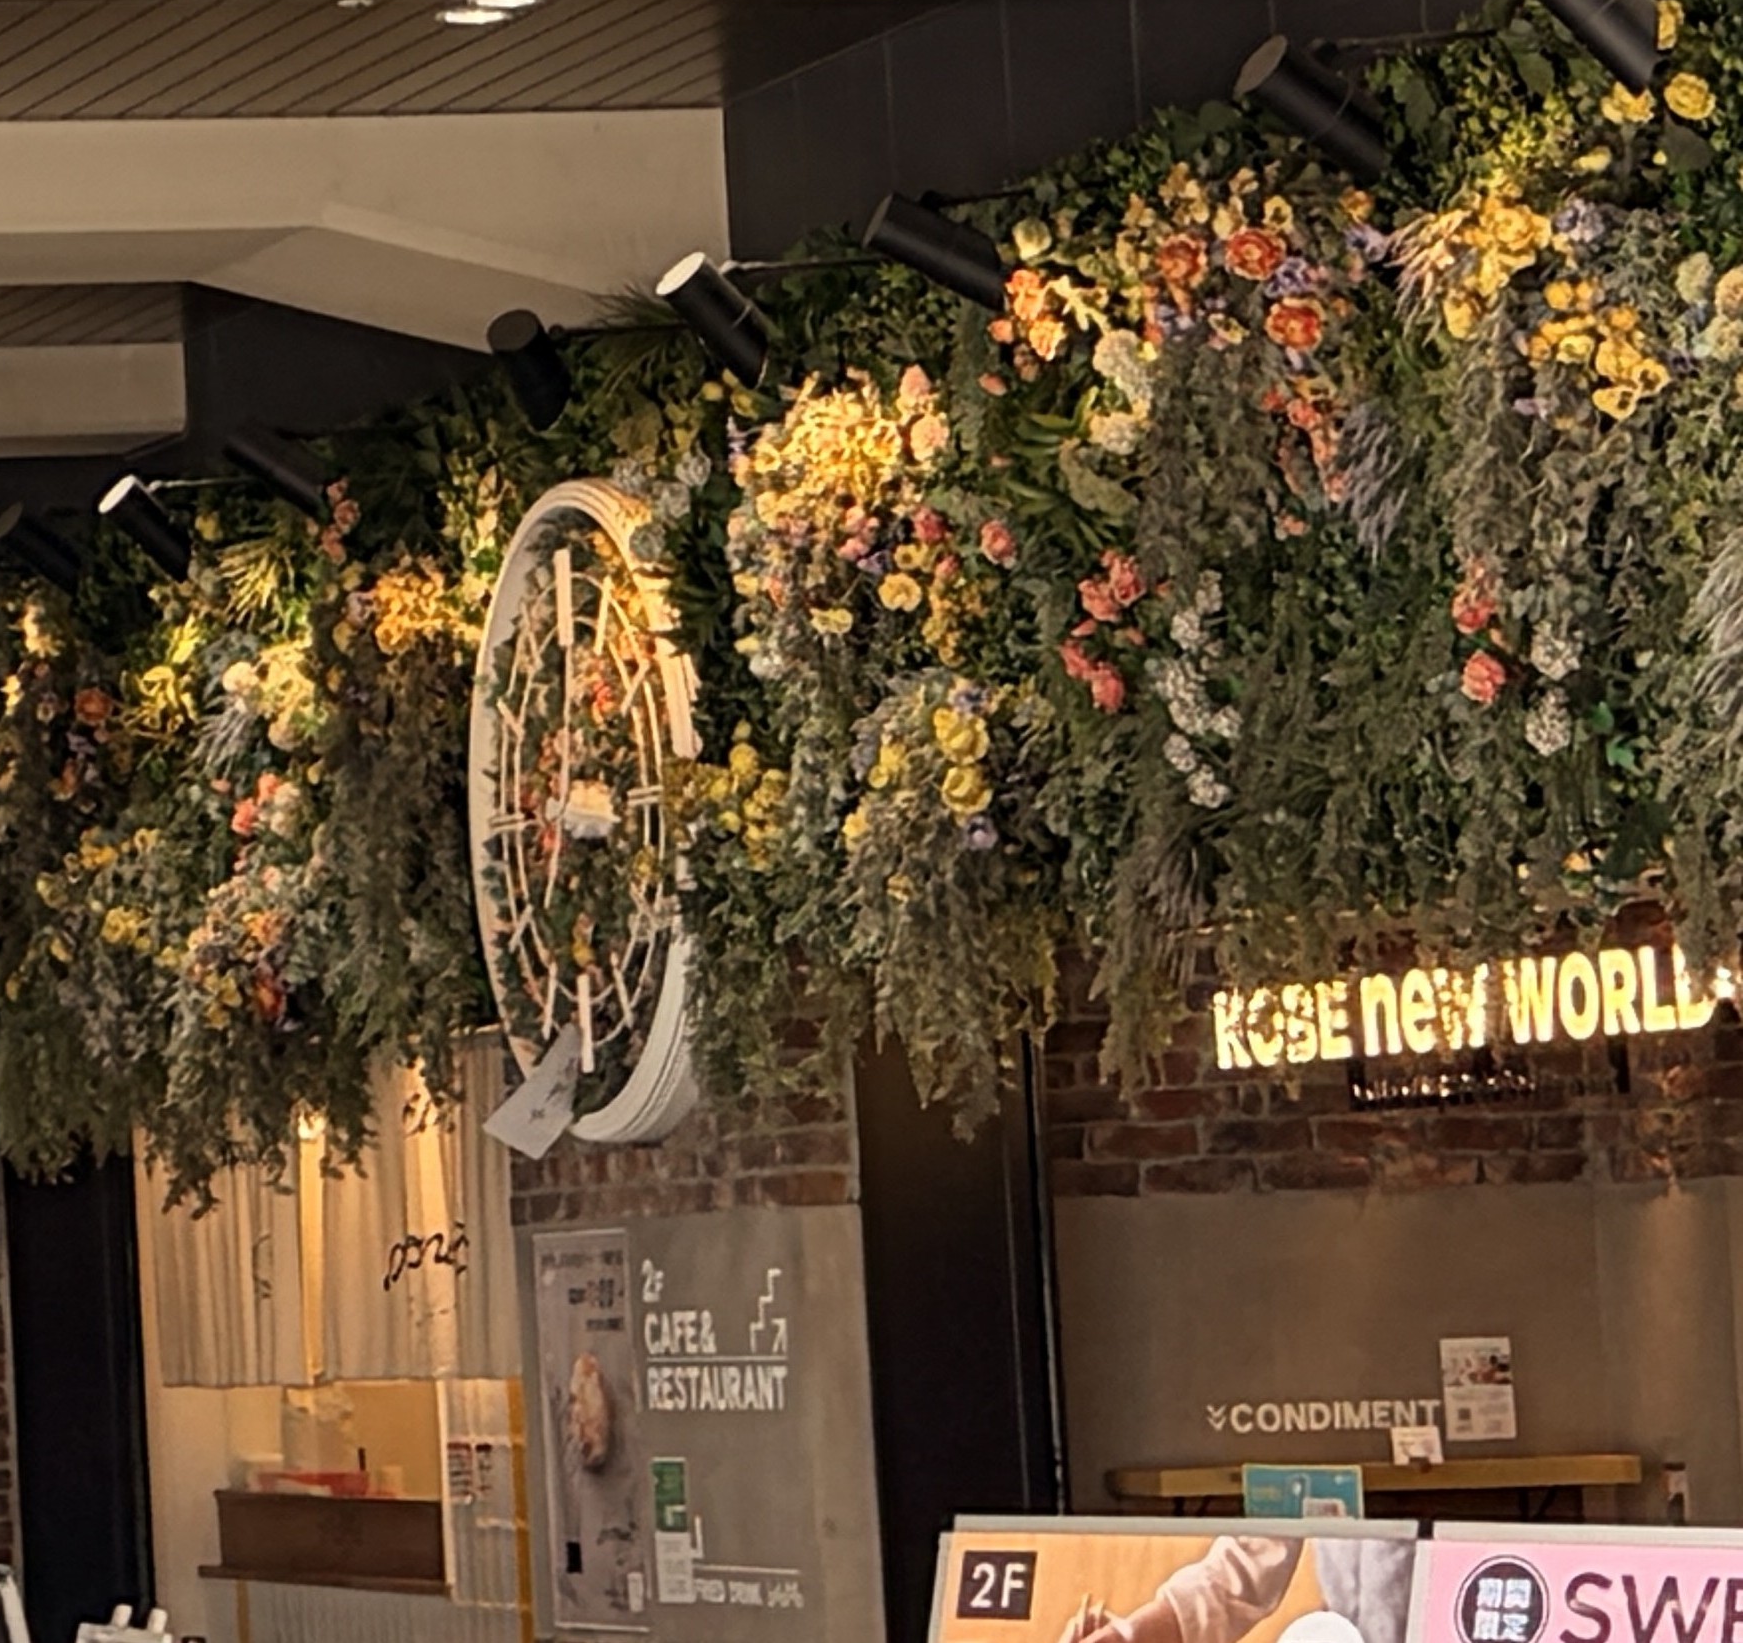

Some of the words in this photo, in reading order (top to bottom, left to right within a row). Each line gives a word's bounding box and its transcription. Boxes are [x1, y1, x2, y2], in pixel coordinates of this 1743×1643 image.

[646, 1364, 788, 1412] RESTAURANT
[1229, 1398, 1442, 1434] CONDIMENT
[969, 1561, 1026, 1609] 2F
